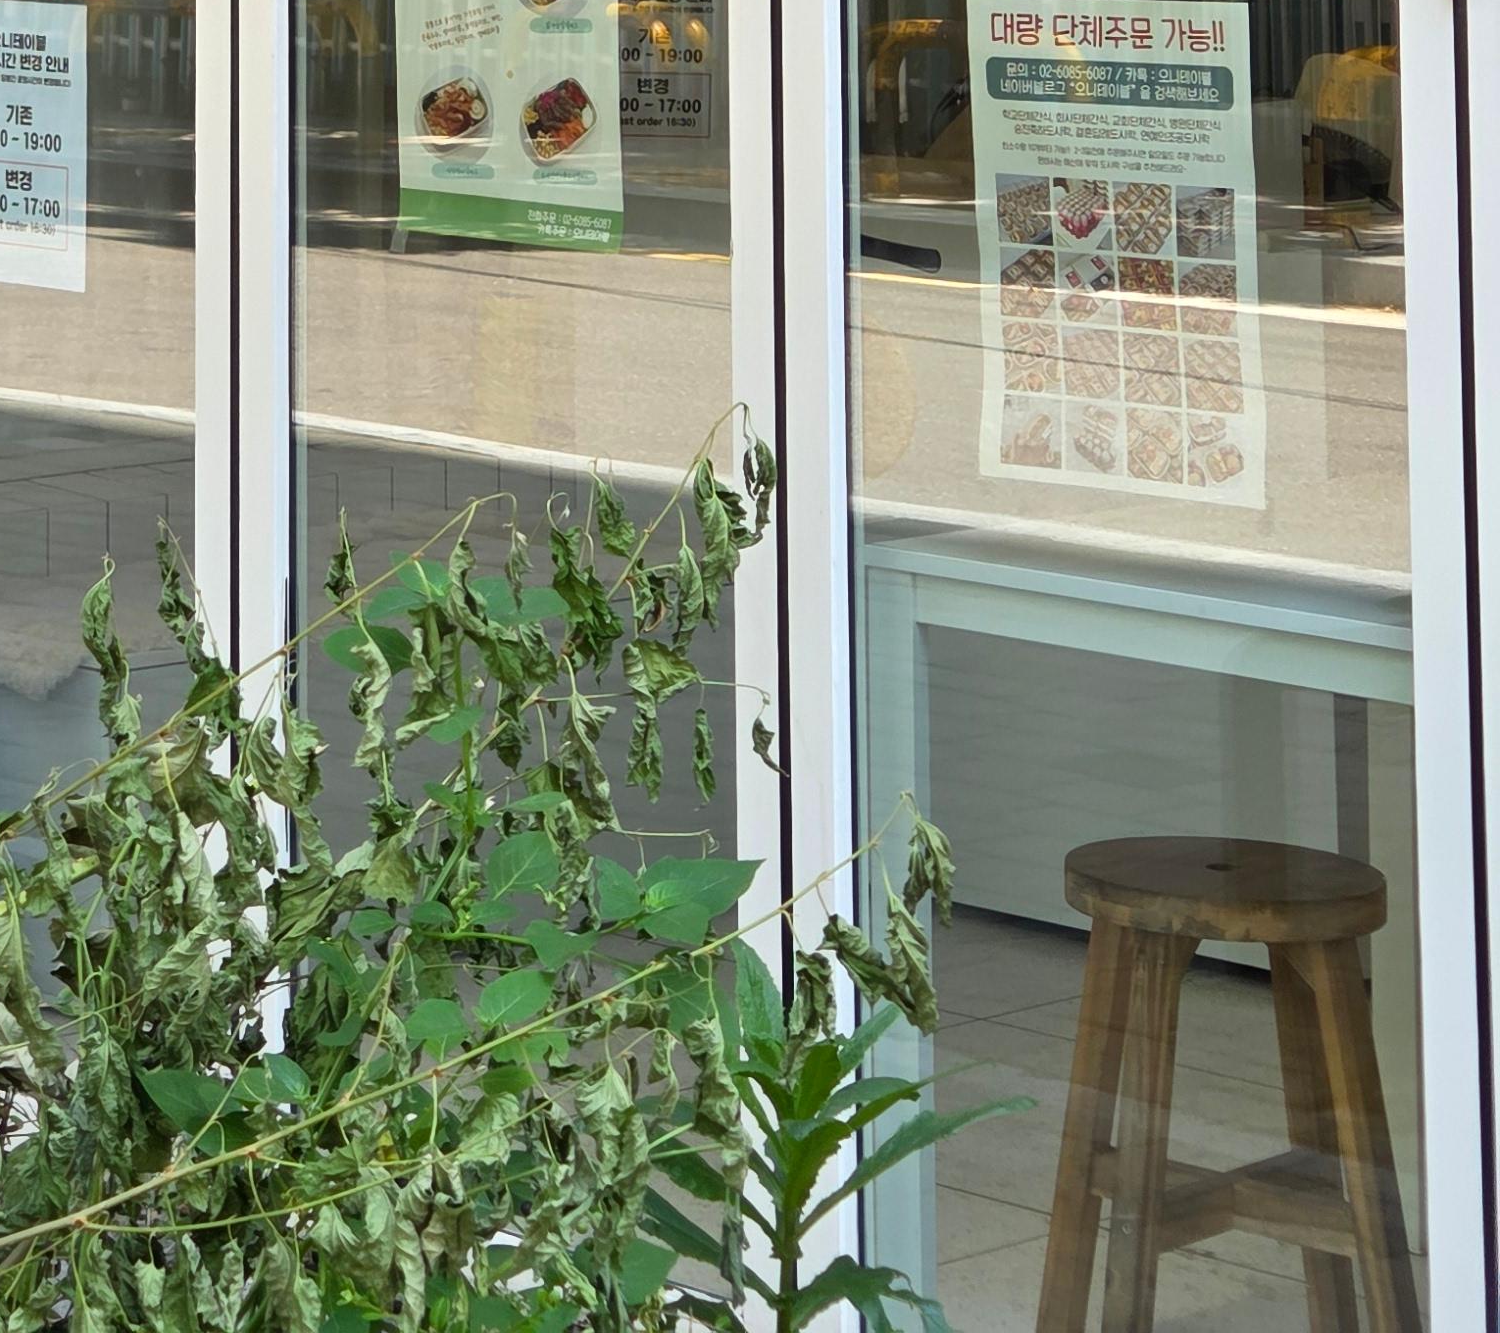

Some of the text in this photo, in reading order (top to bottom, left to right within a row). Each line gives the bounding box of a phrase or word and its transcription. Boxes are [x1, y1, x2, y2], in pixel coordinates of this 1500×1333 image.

[990, 12, 1226, 53] 대량 단체주문 가능!!
[20, 53, 43, 72] 변경
[46, 55, 70, 74] 안내
[659, 47, 703, 63] 19:00
[1006, 61, 1029, 78] 문의
[1038, 64, 1113, 81] 02-6085-6087
[637, 78, 669, 95] 변경
[1154, 85, 1220, 104] 검색해보세요
[5, 104, 33, 126] 기존
[658, 98, 702, 114] 17:00
[636, 117, 663, 127] order
[23, 131, 62, 153] 19:00
[5, 169, 33, 192] 변경
[23, 197, 61, 219] 17:00
